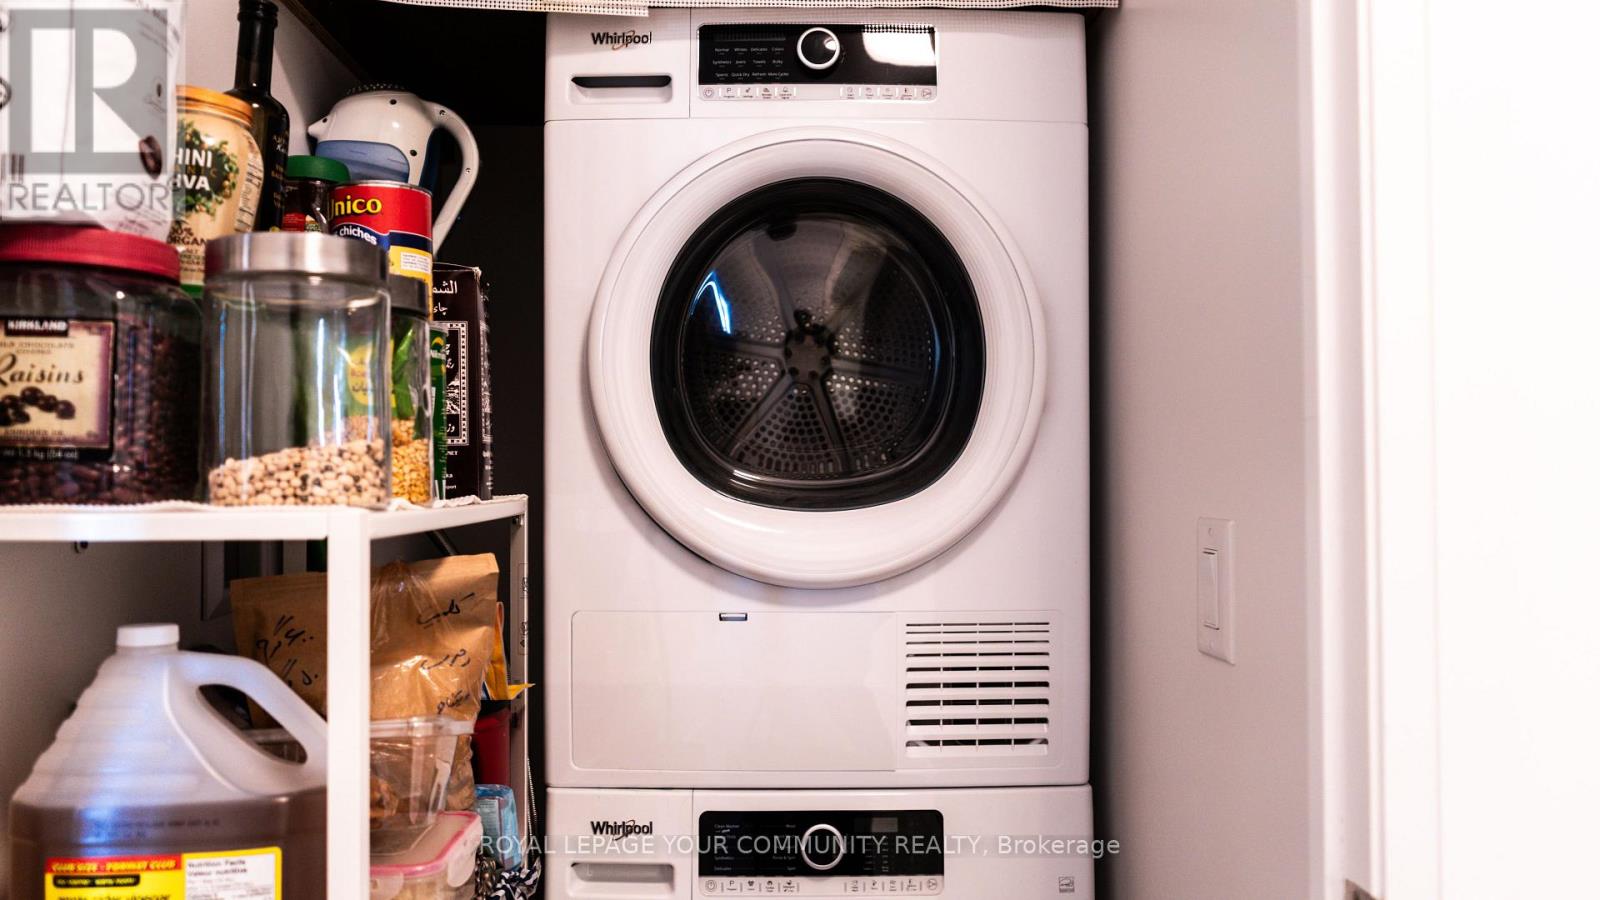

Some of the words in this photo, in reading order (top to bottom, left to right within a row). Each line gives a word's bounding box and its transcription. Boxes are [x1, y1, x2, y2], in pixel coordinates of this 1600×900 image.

[591, 31, 652, 48] Whirlpool
[339, 225, 378, 246] chiches
[8, 320, 67, 331] KIRKLAND
[591, 821, 653, 838] Whirlpool
